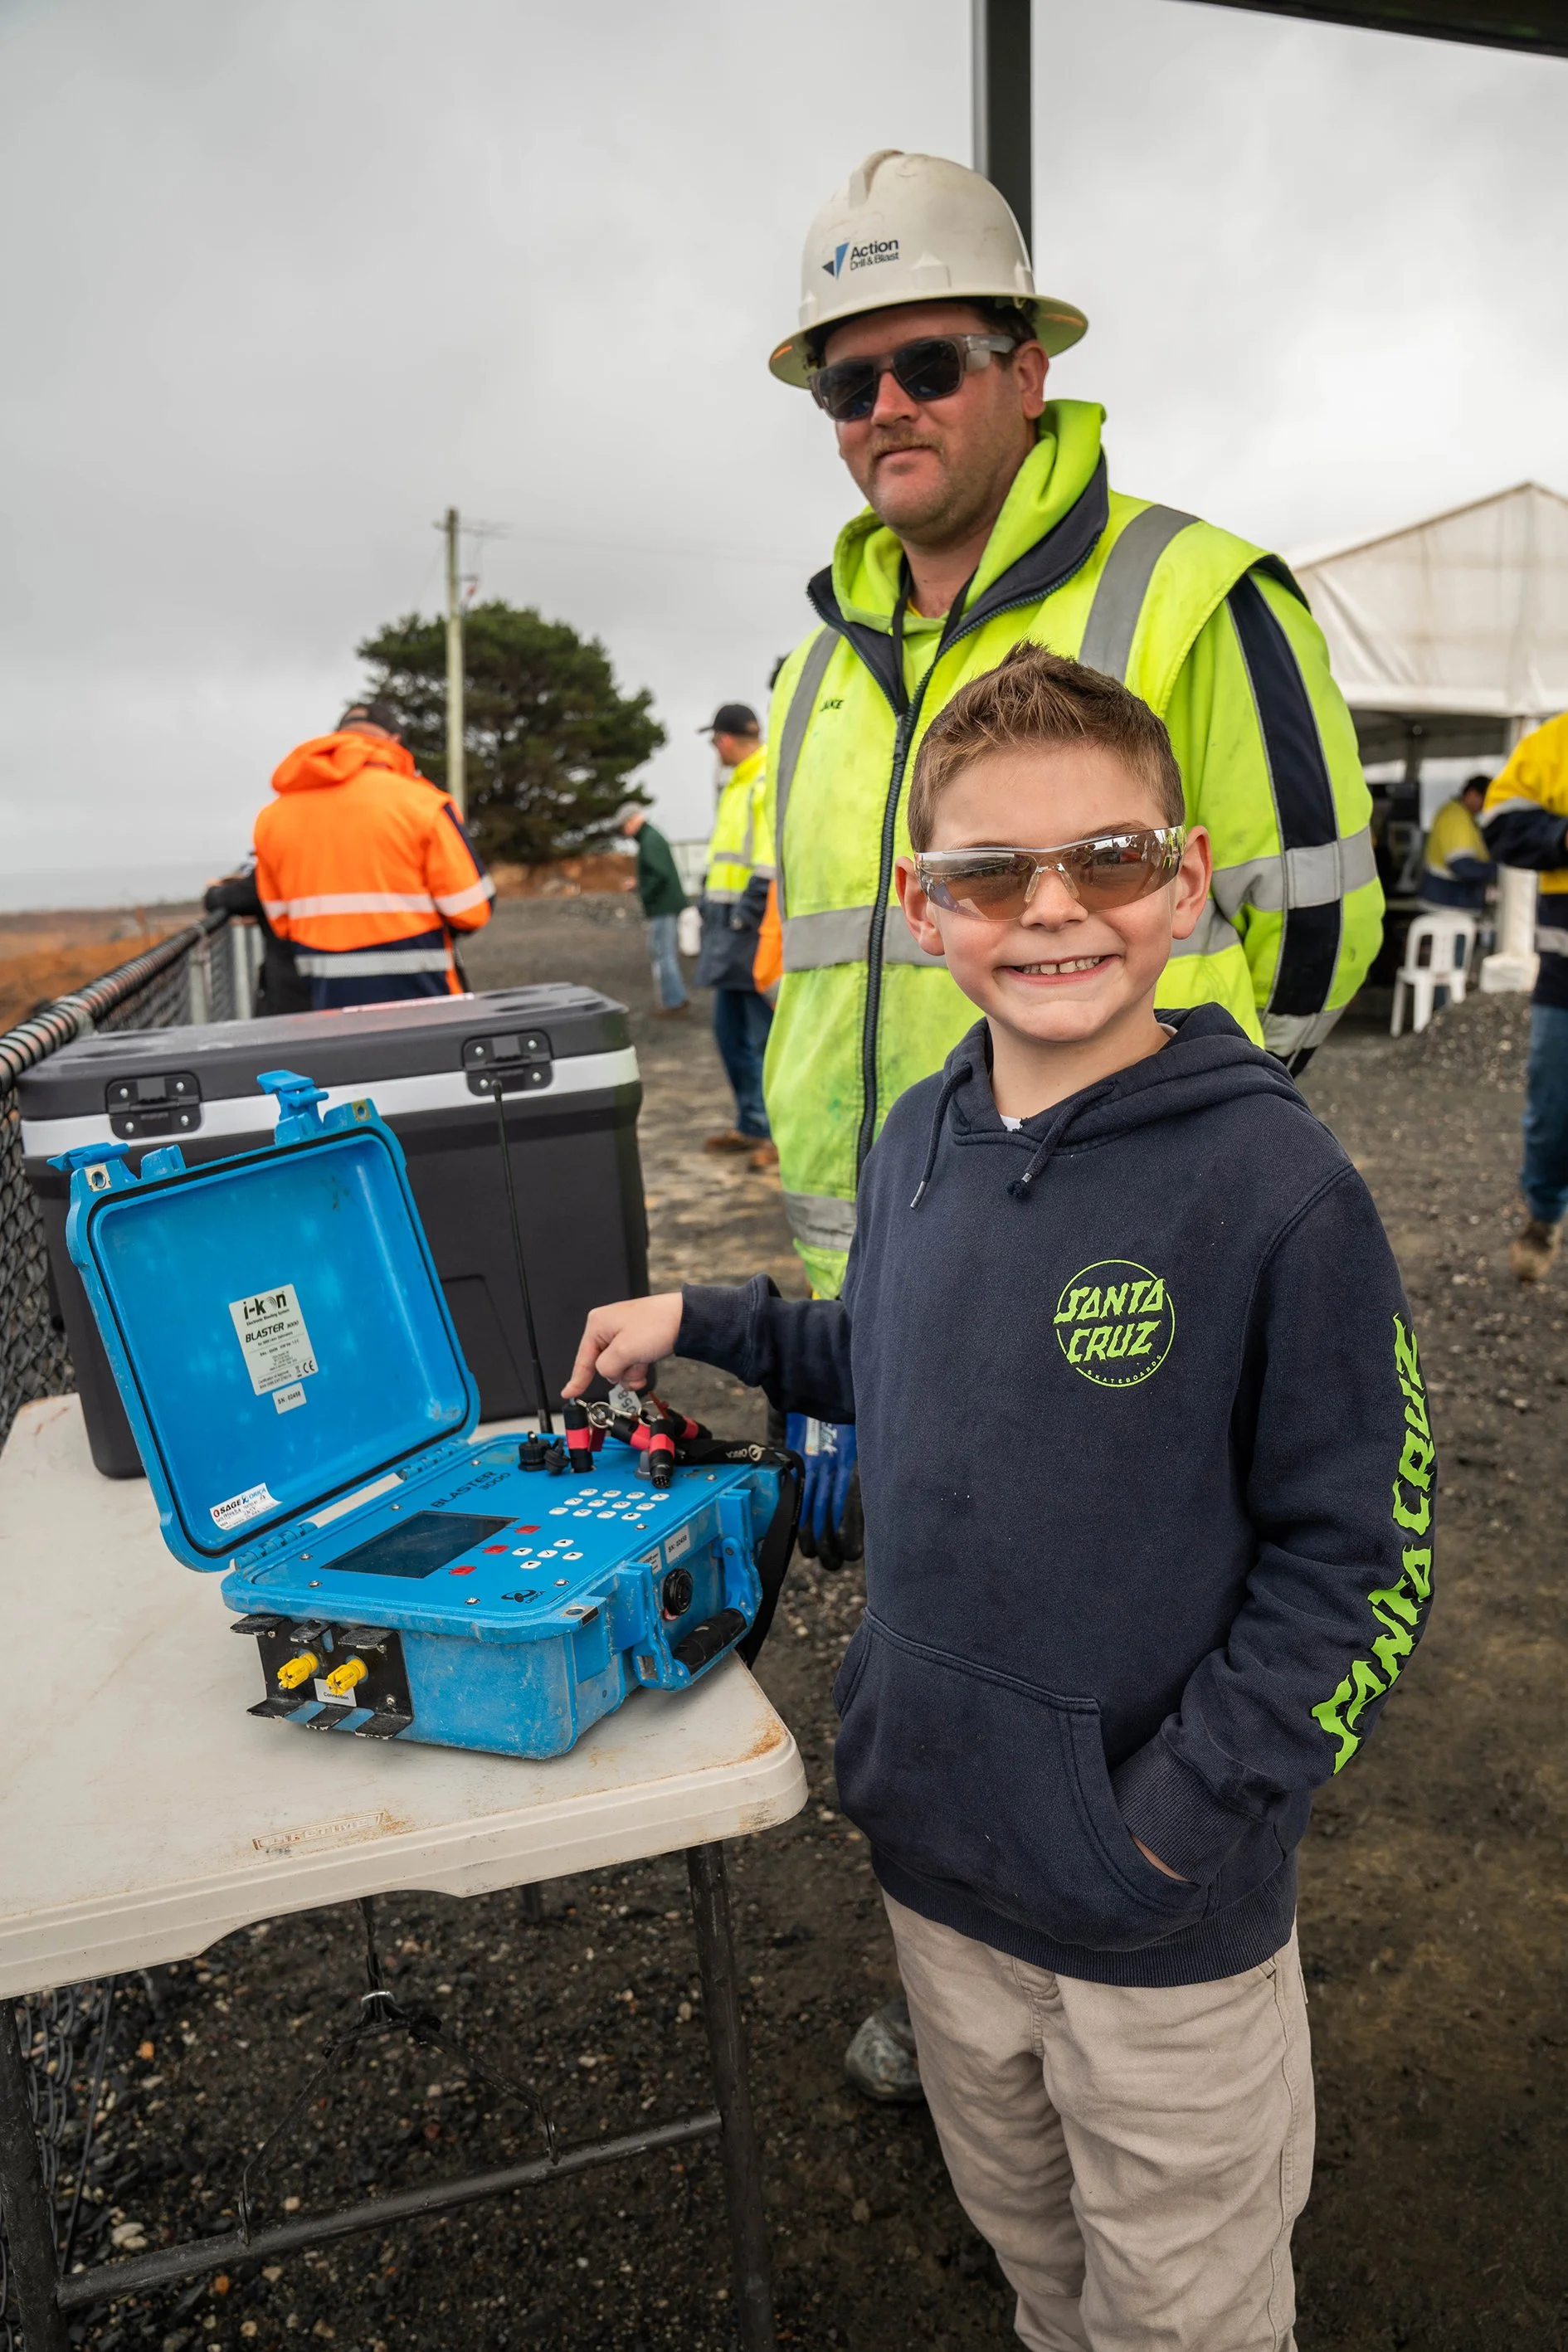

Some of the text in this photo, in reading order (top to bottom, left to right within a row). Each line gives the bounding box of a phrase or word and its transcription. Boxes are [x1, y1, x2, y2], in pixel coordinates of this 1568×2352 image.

[850, 239, 898, 260] Action
[874, 252, 899, 264] Blast
[1053, 1278, 1166, 1324] SANTA
[245, 1322, 285, 1343] BLASTER
[1066, 1320, 1161, 1364] CRUZ
[1088, 1355, 1162, 1383] SKATEBOARDS
[617, 1390, 636, 1413] 058
[1392, 1312, 1435, 1536] CRUZ
[431, 1471, 498, 1508] BLASTER
[479, 1473, 511, 1491] 3000
[220, 1498, 241, 1514] SAGE
[249, 1487, 266, 1500] ORICA
[525, 1590, 546, 1604] ORICA
[1312, 1543, 1434, 1776] SANTA
